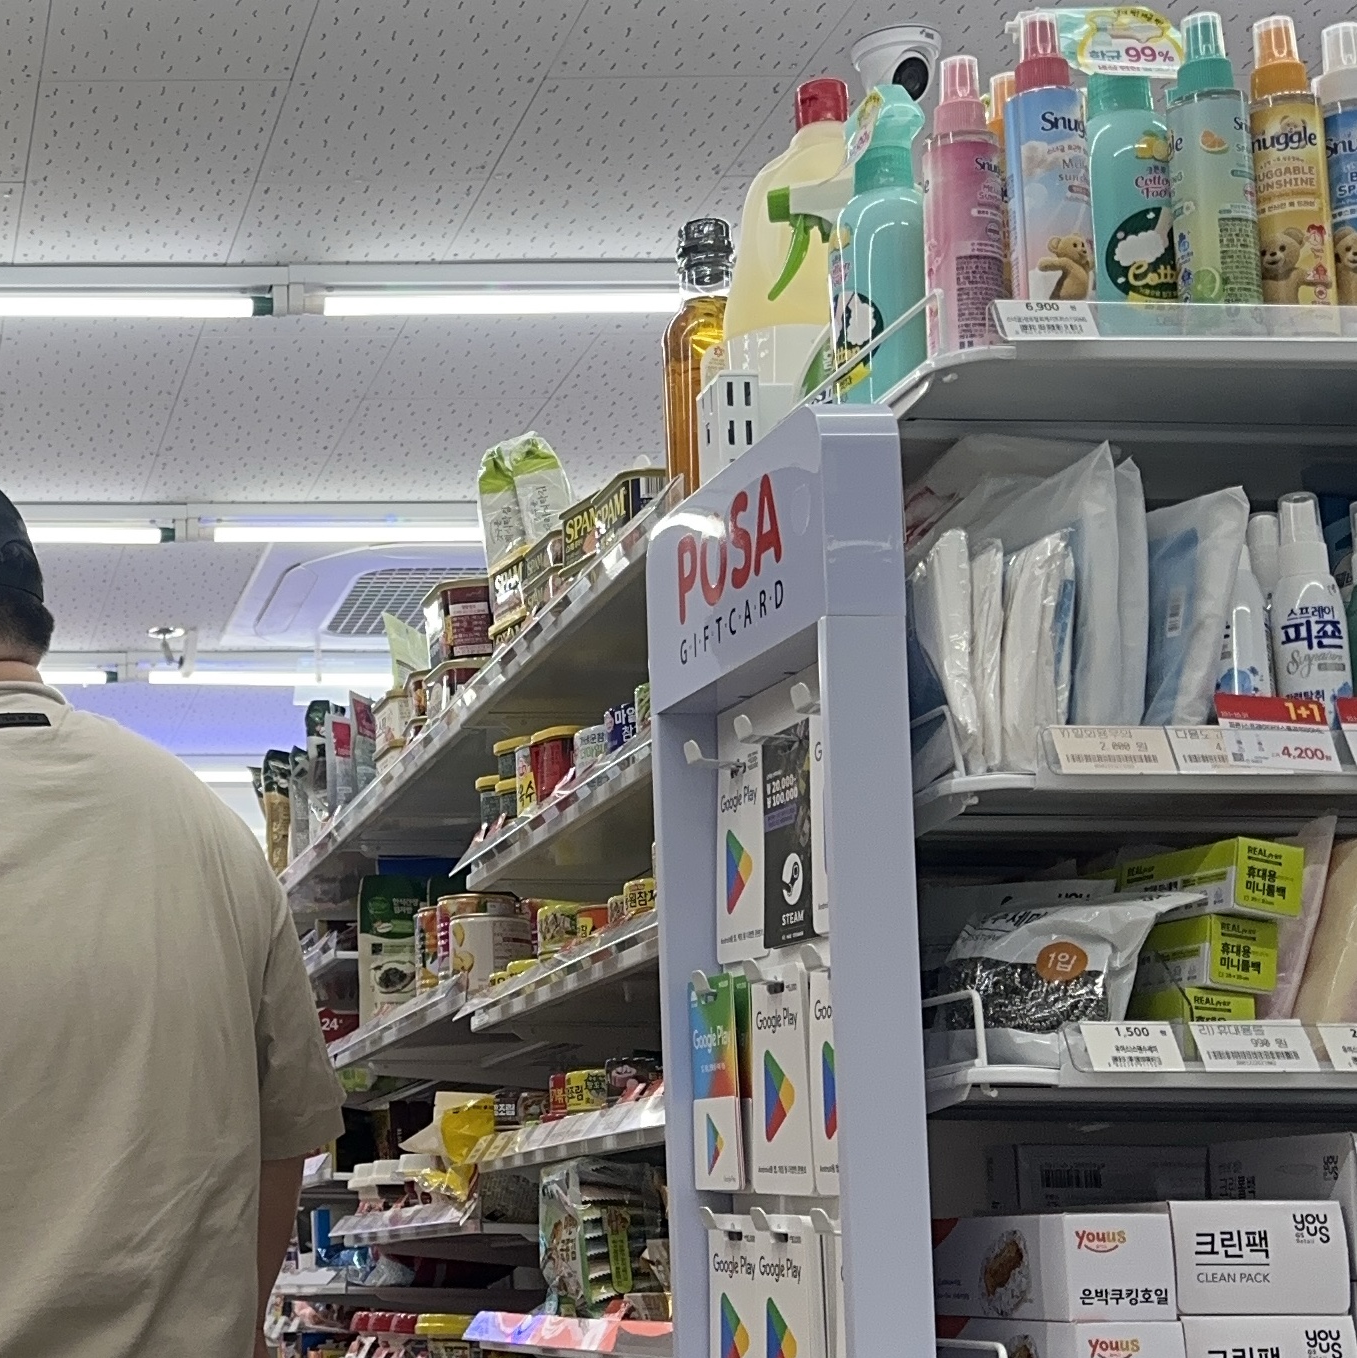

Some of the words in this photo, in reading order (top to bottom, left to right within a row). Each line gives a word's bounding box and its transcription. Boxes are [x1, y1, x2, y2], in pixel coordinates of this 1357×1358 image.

[1125, 46, 1174, 63] 99%
[1026, 302, 1059, 312] 6,900
[1286, 606, 1335, 620] 스프레이
[1281, 620, 1344, 651] 피죤
[1285, 701, 1322, 722] 1+1
[1282, 745, 1325, 761] 4,200
[720, 789, 742, 814] Google
[743, 784, 759, 805] Play
[1246, 864, 1277, 883] 휴대용
[781, 909, 805, 927] STEAM
[1220, 941, 1252, 959] 휴대용
[1046, 949, 1076, 973] 1입
[756, 1011, 782, 1034] Google
[782, 1008, 798, 1030] Play
[1114, 1026, 1150, 1038] 1,500
[1075, 1229, 1127, 1251] youus
[1194, 1229, 1270, 1260] 크린팩
[713, 1252, 739, 1279] Google
[739, 1255, 756, 1280] Play
[758, 1255, 784, 1283] Google
[784, 1257, 802, 1285] Play
[1196, 1271, 1237, 1284] CLEAN
[1239, 1271, 1271, 1284] PACK
[1079, 1287, 1169, 1307] 은박쿠킹호일
[1088, 1337, 1140, 1358] youus
